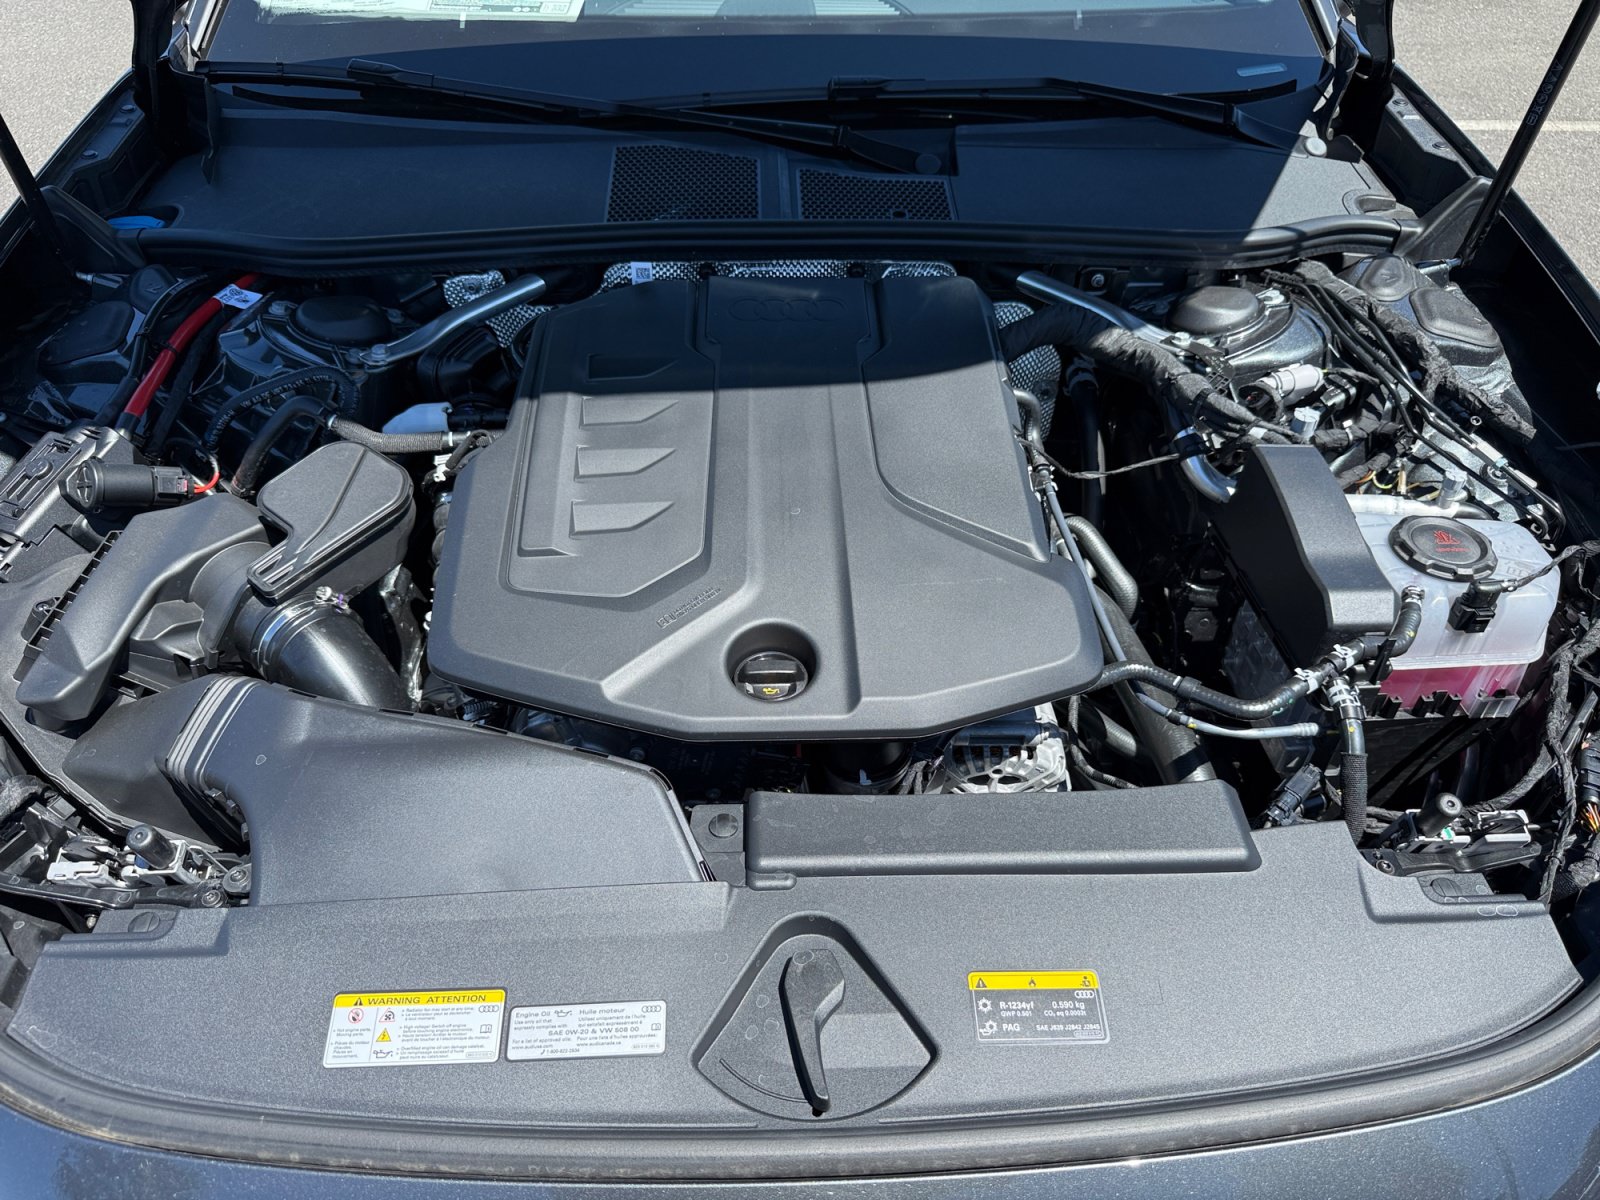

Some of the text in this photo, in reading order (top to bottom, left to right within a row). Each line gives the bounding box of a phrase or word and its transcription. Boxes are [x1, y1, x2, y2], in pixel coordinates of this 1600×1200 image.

[368, 994, 487, 1005] WARNING ATTENTION
[1000, 1001, 1034, 1010] R-1234yf
[1052, 1001, 1085, 1010] 0.590 kg
[1002, 1024, 1020, 1032] PAG
